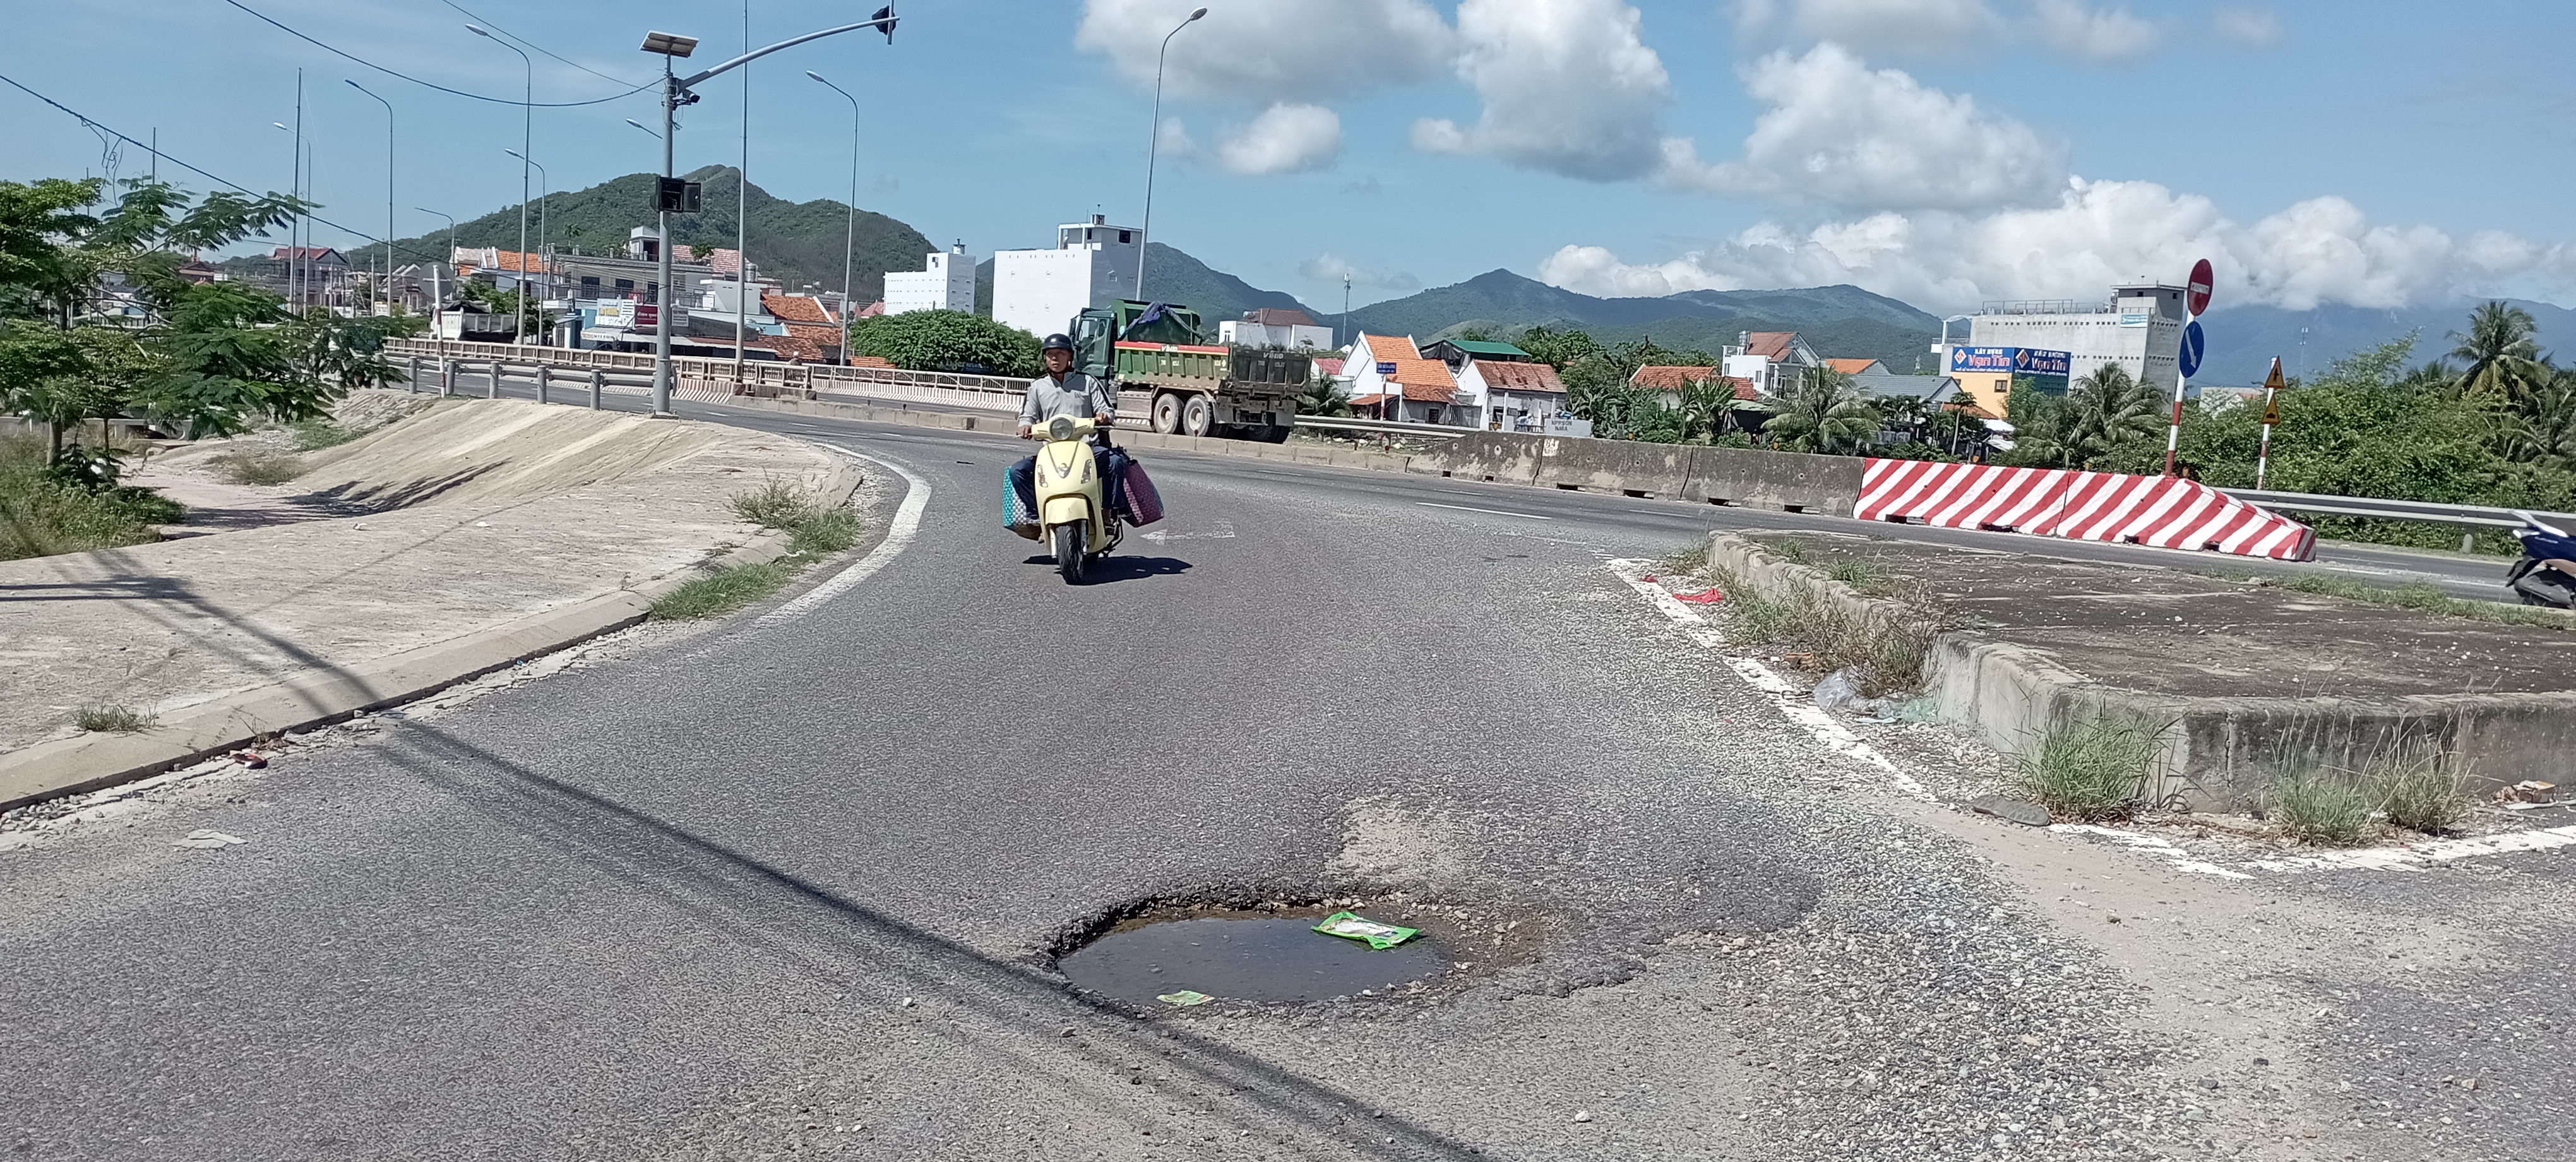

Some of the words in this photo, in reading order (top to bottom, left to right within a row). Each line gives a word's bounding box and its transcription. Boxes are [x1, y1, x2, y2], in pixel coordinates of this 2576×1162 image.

[1968, 354, 1991, 368] Vạn
[1991, 354, 2010, 367] Tín
[2031, 357, 2051, 371] Vạn
[2052, 359, 2068, 371] Tín
